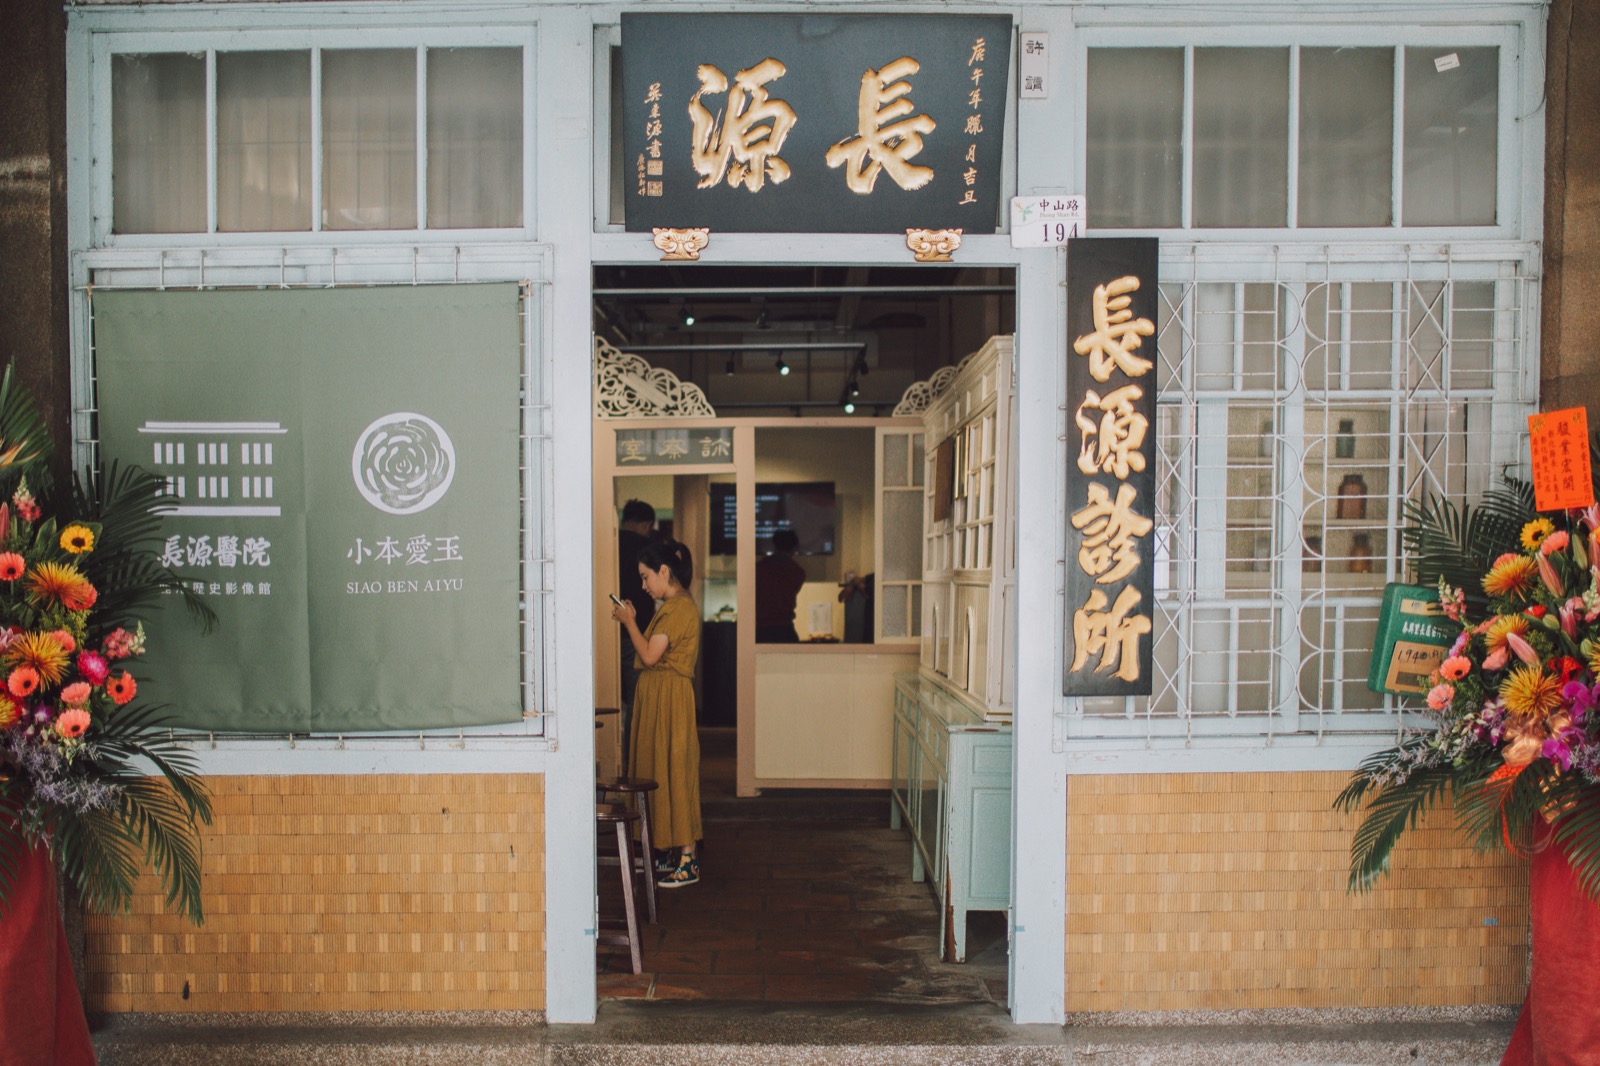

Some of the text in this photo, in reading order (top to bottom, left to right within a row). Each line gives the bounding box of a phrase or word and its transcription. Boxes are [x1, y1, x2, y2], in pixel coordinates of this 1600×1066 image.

[688, 55, 937, 195] 長源
[1039, 198, 1079, 212] 中山路
[1043, 222, 1078, 242] 194
[1069, 274, 1156, 684] 長源診所
[156, 534, 271, 568] 長源醫院
[347, 534, 464, 566] 小本愛玉
[346, 578, 464, 594] SIAO BEN AIYU
